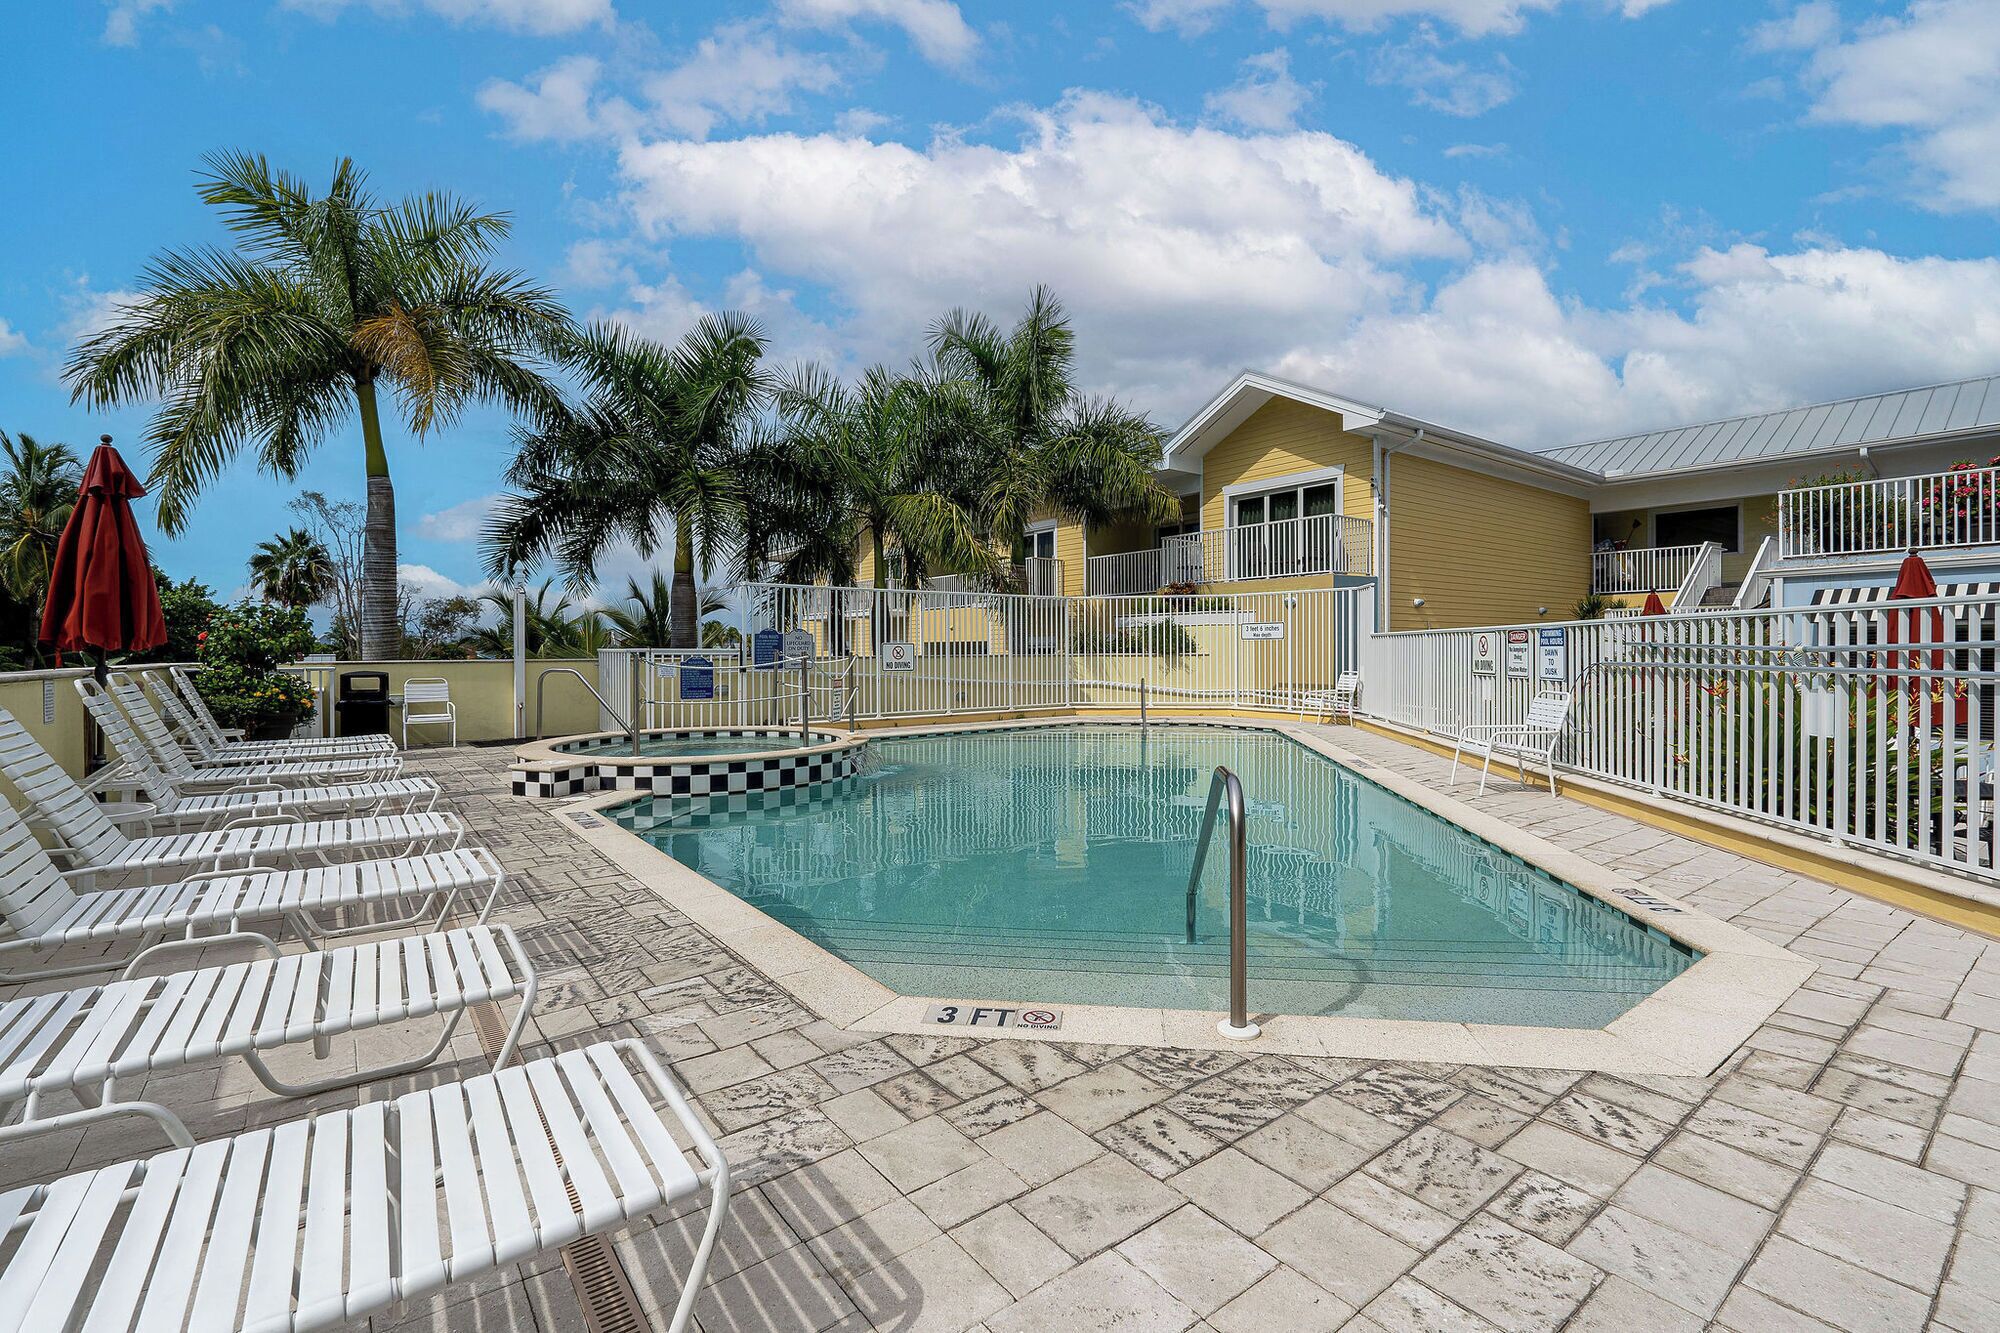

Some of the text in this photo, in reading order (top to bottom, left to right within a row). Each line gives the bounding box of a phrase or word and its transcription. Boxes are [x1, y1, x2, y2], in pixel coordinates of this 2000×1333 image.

[1510, 632, 1526, 640] DANGER
[1550, 637, 1564, 645] HOURS
[1544, 648, 1558, 656] DAWN
[886, 661, 911, 670] NO DIVING
[1480, 660, 1494, 671] DIVING
[1544, 667, 1558, 676] DUSK
[936, 1006, 1016, 1026] 3 FT
